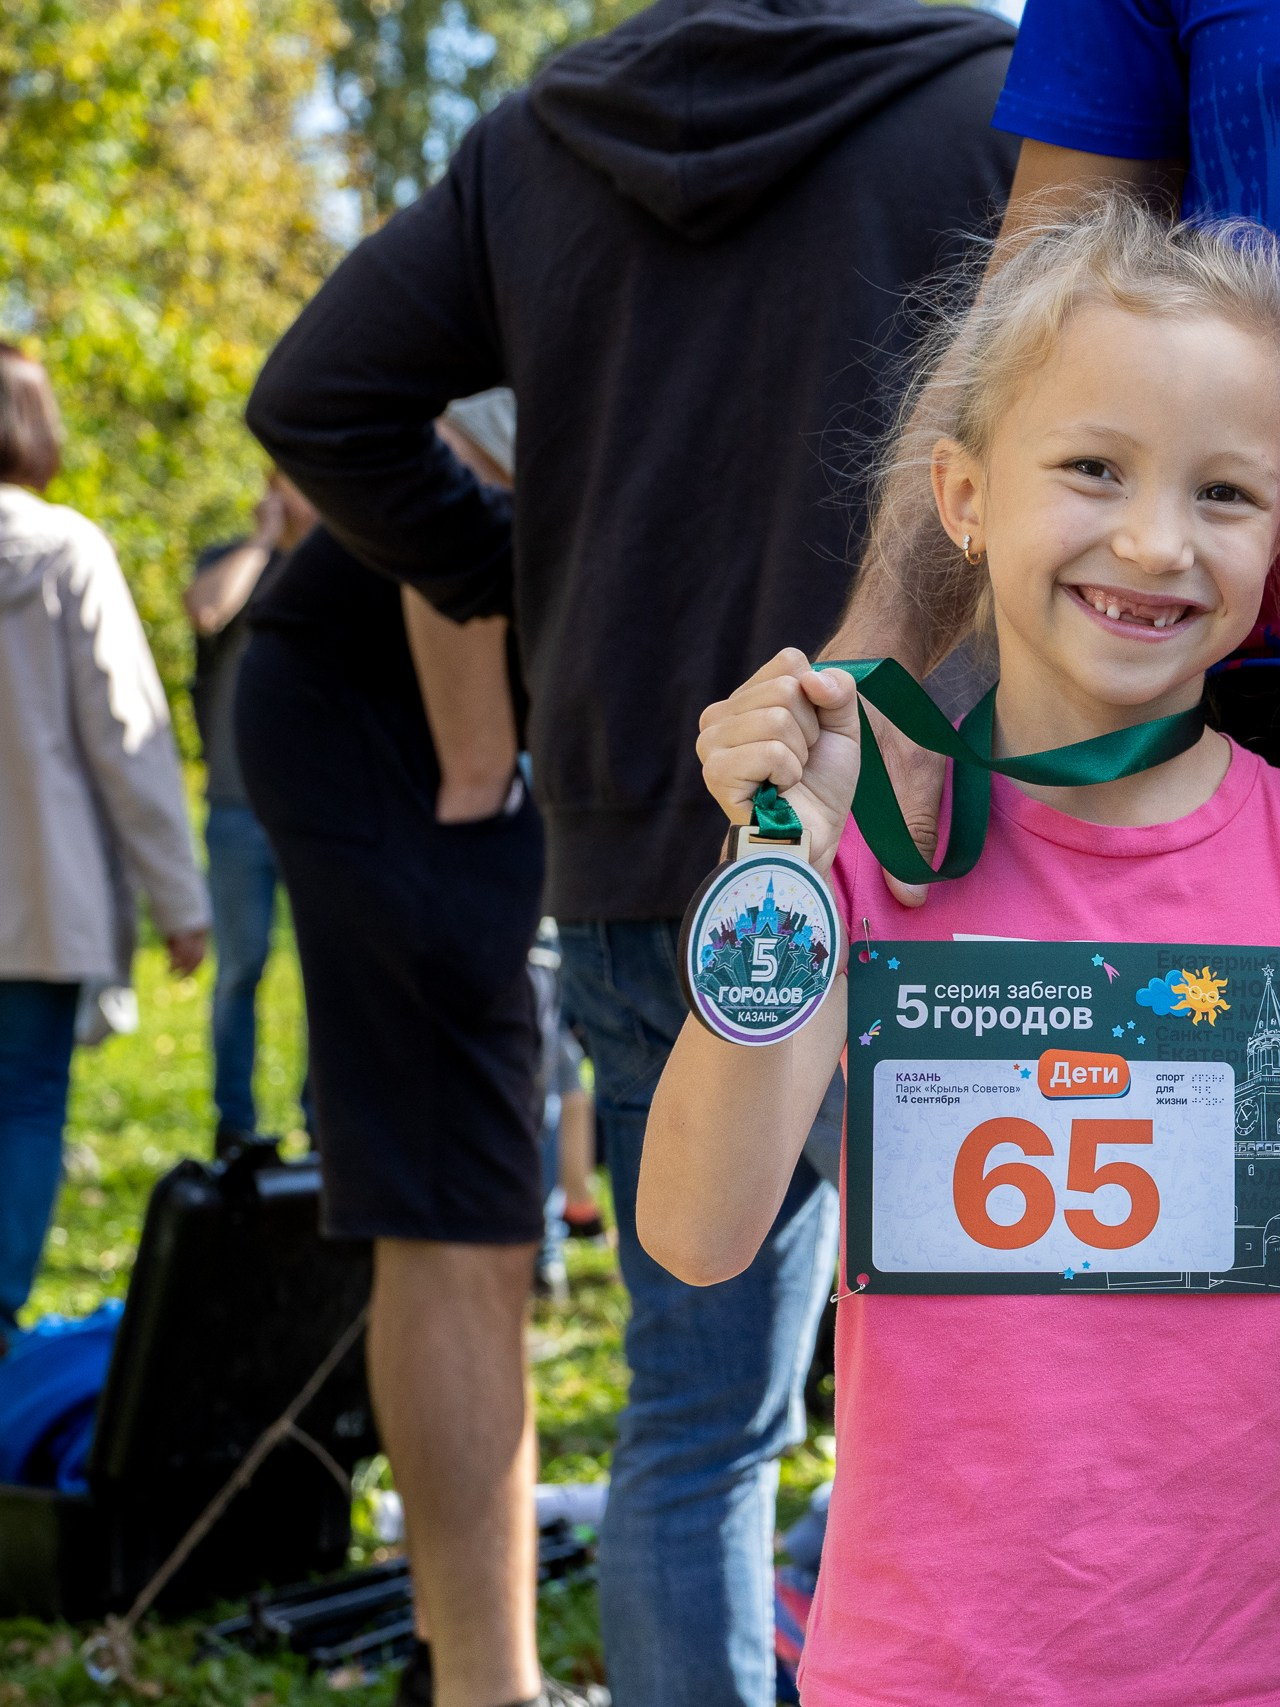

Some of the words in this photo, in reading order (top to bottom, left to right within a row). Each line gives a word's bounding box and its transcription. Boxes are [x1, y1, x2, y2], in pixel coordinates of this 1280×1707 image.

[750, 938, 778, 982] 5
[718, 986, 804, 1005] ГОРОДОВ
[934, 984, 1000, 1003] серия
[1007, 981, 1093, 1000] забегов
[896, 984, 929, 1029] 5
[934, 1005, 1094, 1037] городов
[737, 1011, 779, 1023] КАЗАНЬ
[896, 1072, 941, 1082] КАЗАНЬ
[1050, 1061, 1118, 1088] Дети
[1156, 1074, 1185, 1083] спорт
[895, 1084, 921, 1095] Парк
[924, 1084, 969, 1093] «Крылья
[972, 1084, 1021, 1094] Советов»
[1155, 1085, 1175, 1095] для
[895, 1095, 908, 1104] 14
[910, 1095, 961, 1106] сентября
[1156, 1097, 1188, 1105] жизни
[952, 1116, 1161, 1251] 65
